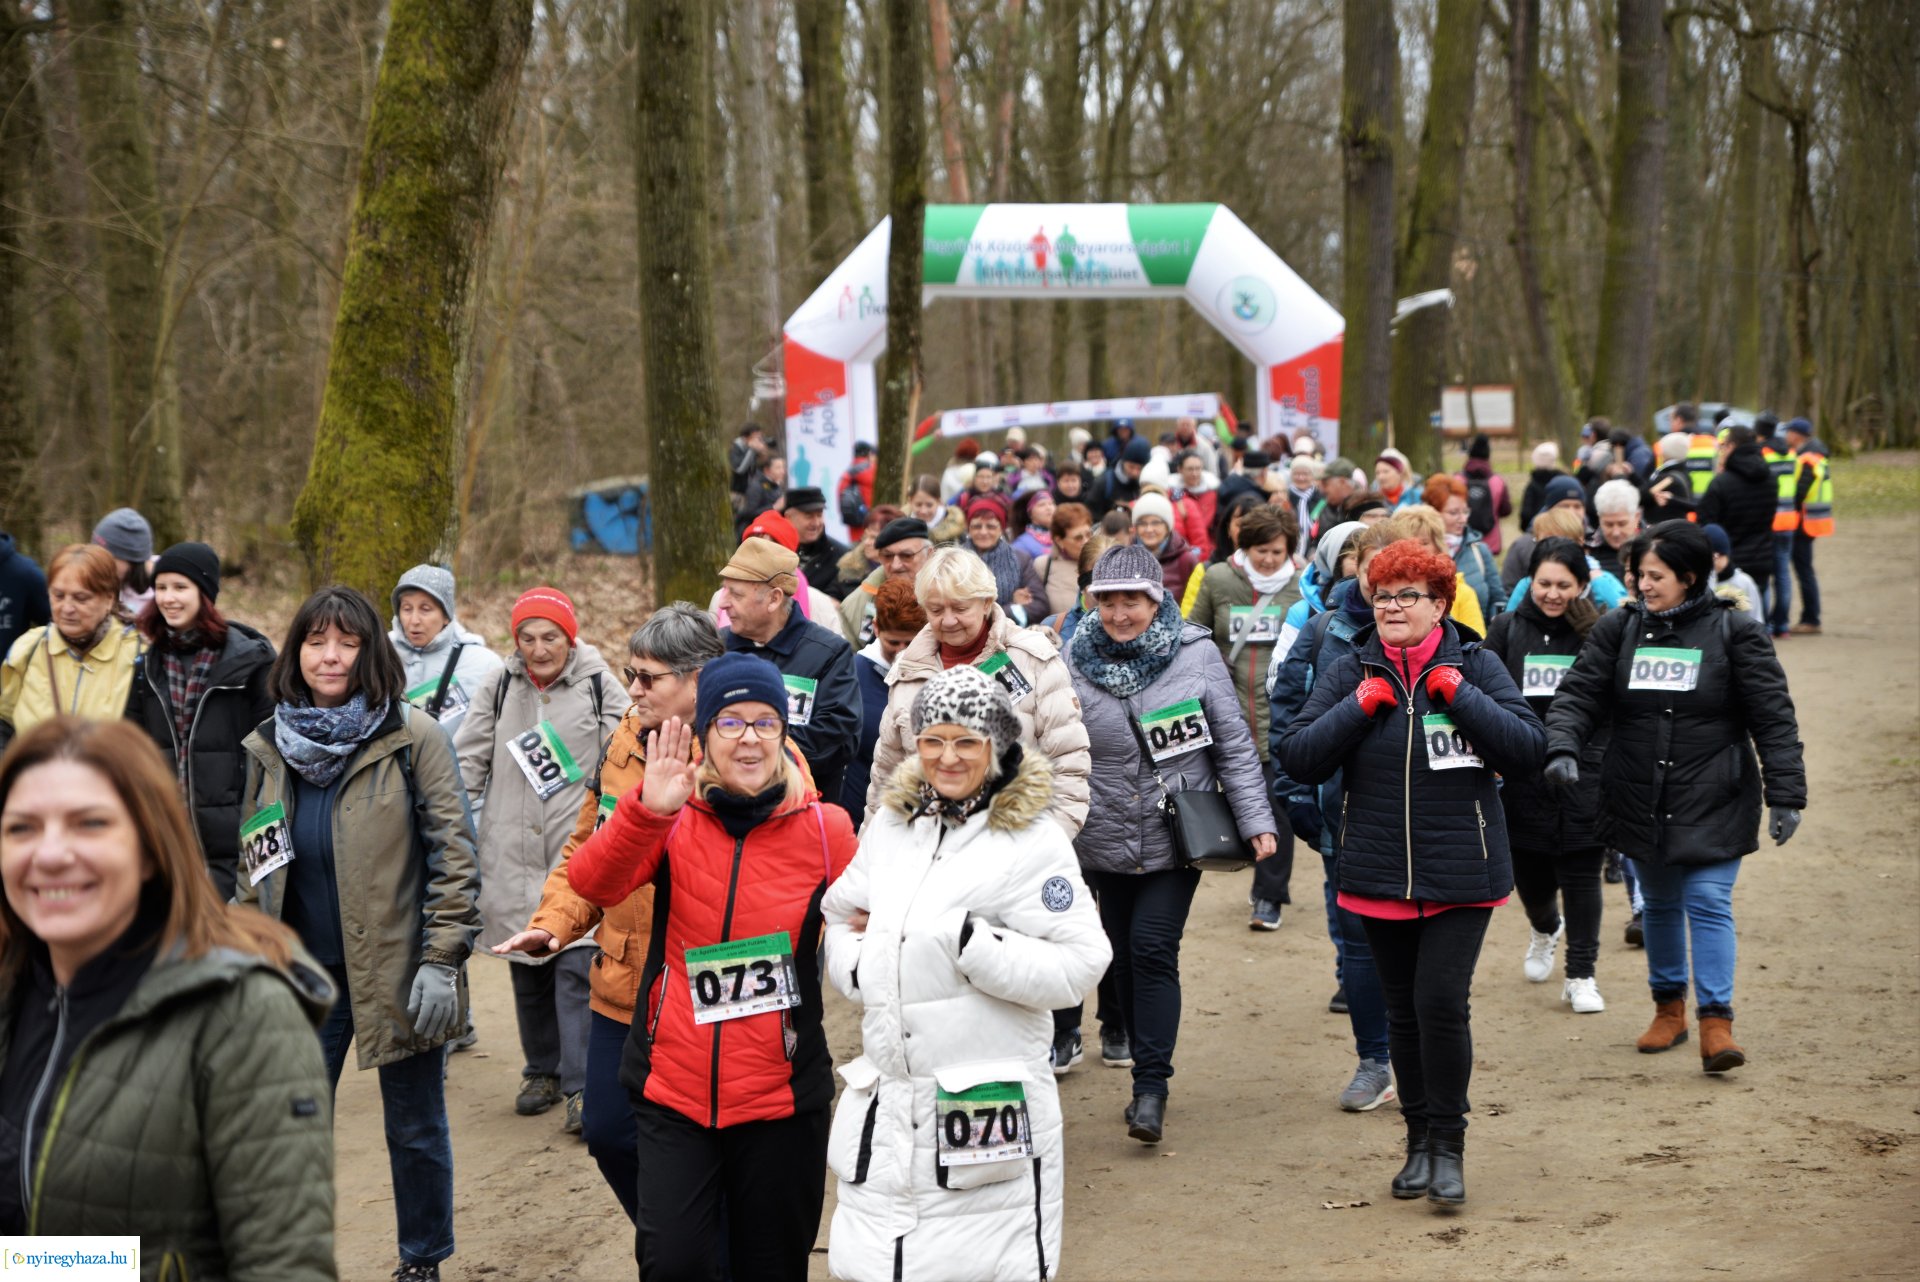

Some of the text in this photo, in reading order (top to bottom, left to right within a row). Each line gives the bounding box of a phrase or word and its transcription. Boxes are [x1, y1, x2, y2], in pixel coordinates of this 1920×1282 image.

[1232, 616, 1270, 633] 05
[1636, 660, 1686, 681] 009
[1150, 714, 1203, 750] 045
[519, 731, 561, 782] 030
[246, 825, 280, 870] 028
[695, 959, 777, 1006] 073
[944, 1104, 1018, 1148] 070
